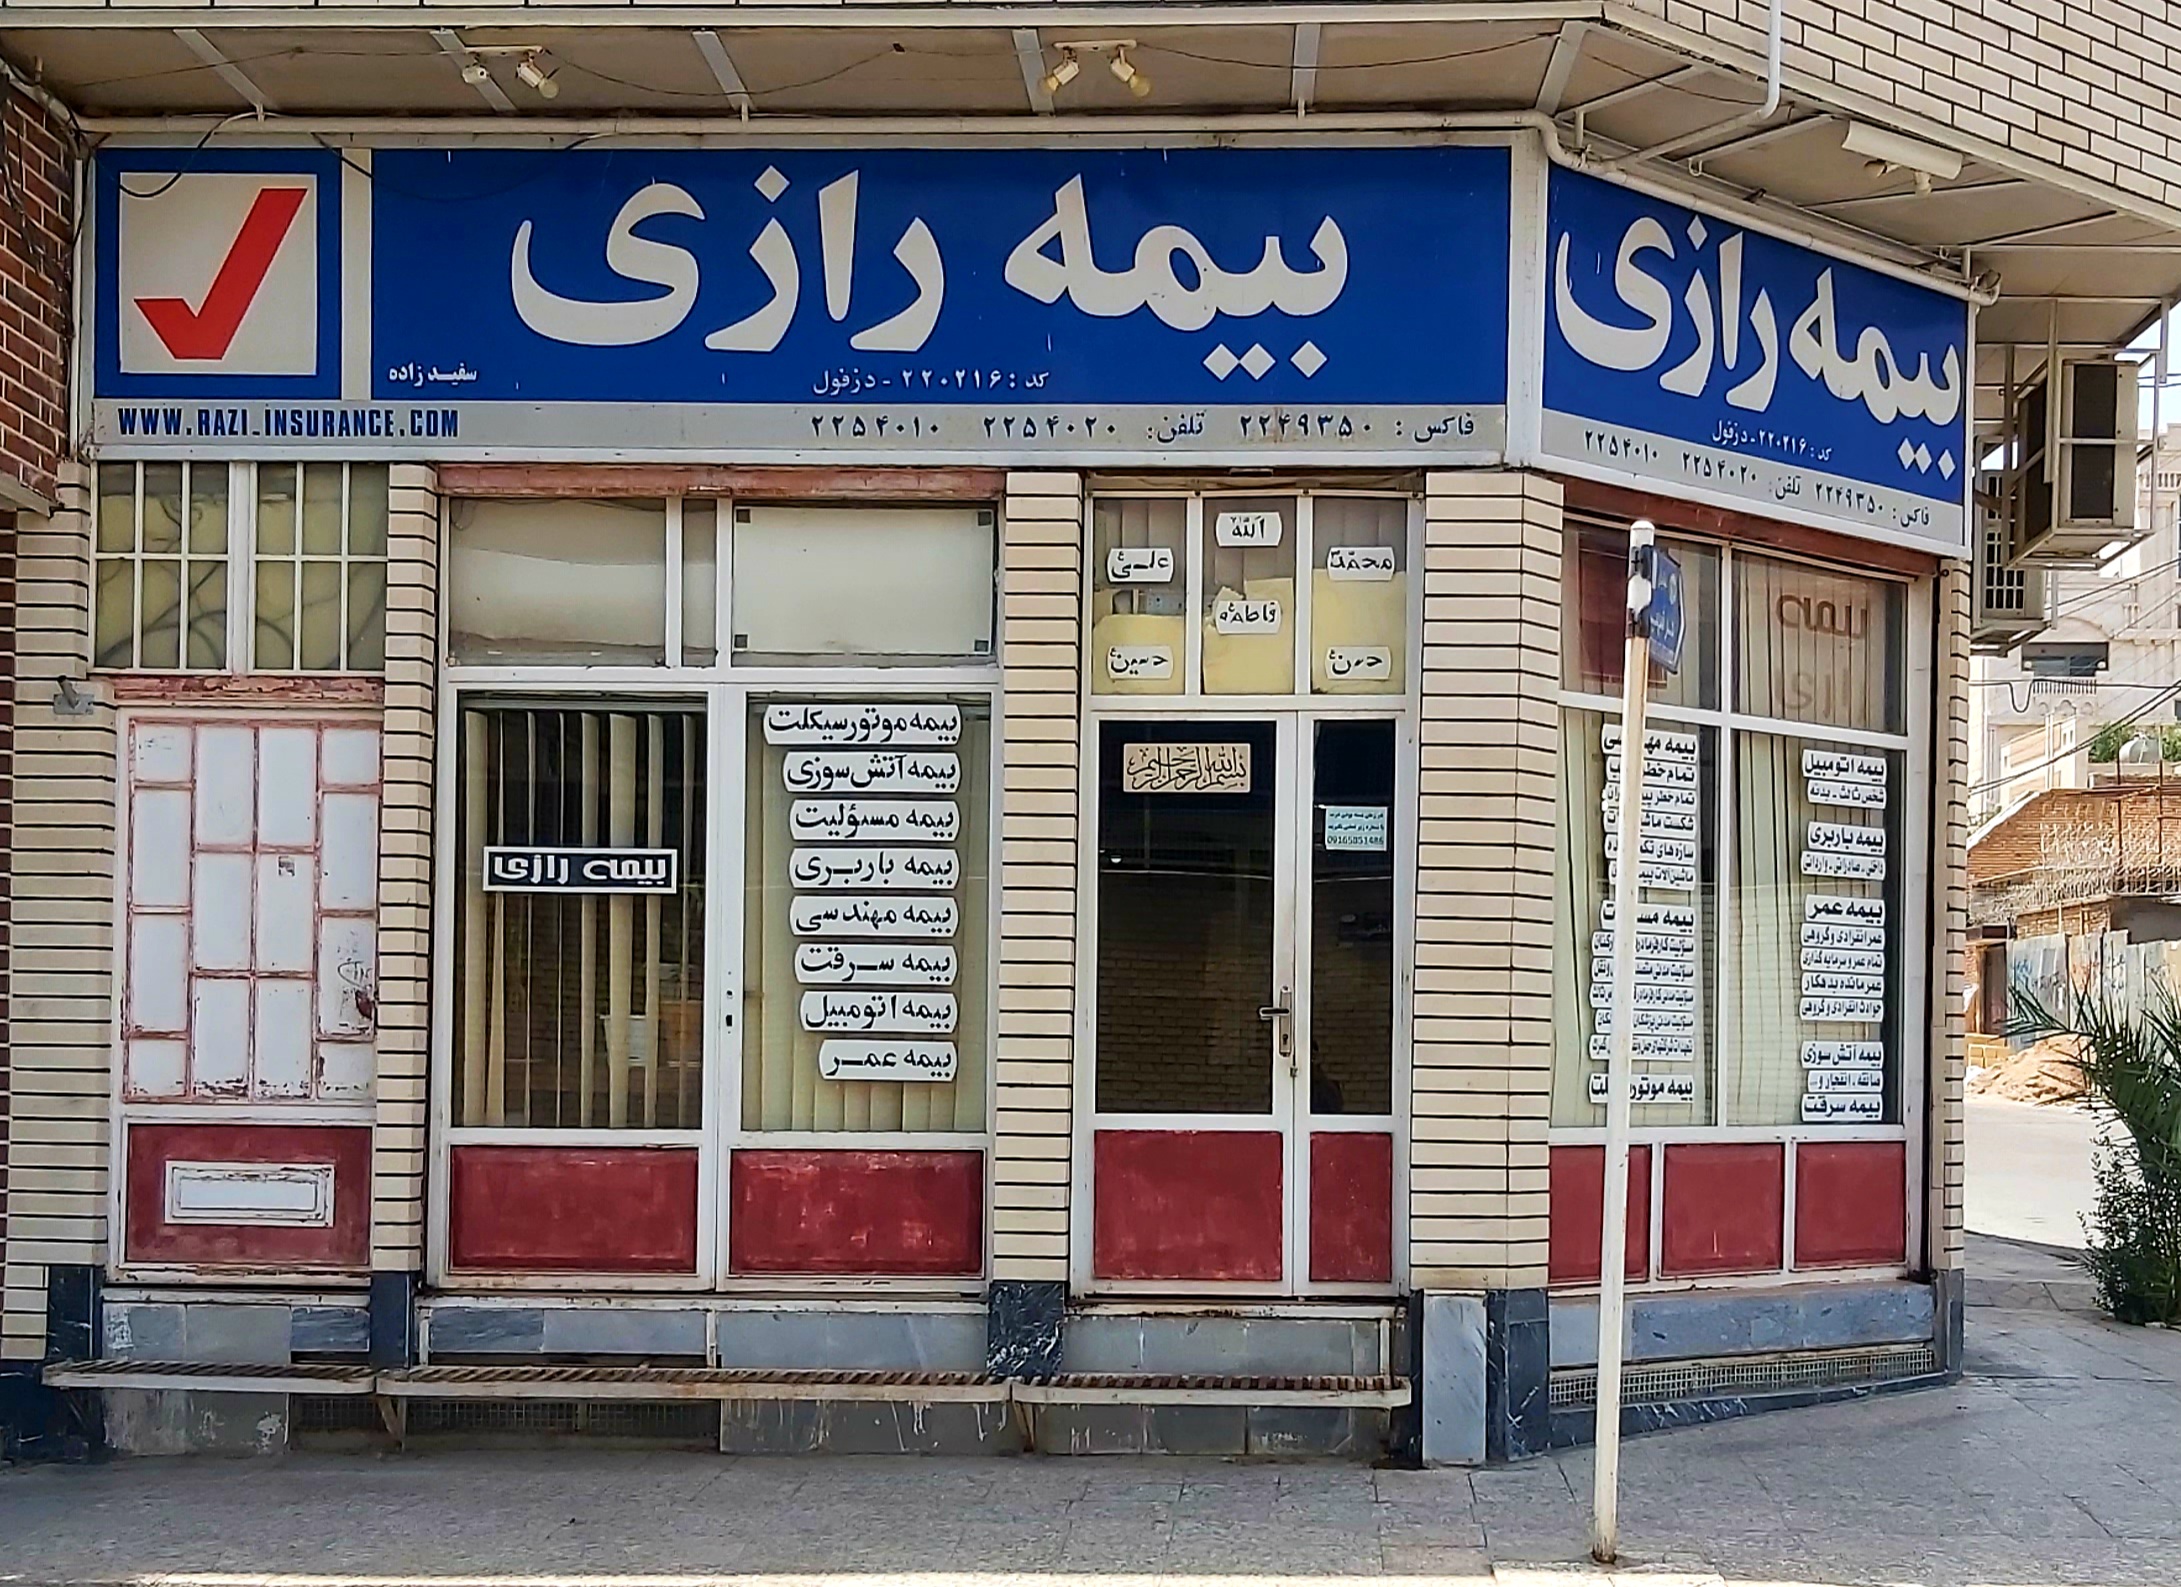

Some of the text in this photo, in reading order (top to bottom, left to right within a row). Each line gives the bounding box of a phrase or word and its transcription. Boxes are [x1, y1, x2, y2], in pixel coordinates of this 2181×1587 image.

[511, 165, 1349, 381] بیمه رازی
[1555, 214, 1962, 481] بیمه رازی
[388, 362, 478, 387] سفید زاده
[812, 367, 877, 396] دزفول
[810, 415, 940, 439] ۲۲۵۴۰۱۰
[982, 415, 1117, 439] ۲۲۵۴۰۲۰
[1239, 412, 1374, 438] ۲۲۴۹۳۵۰
[1711, 419, 1748, 446] دزفول
[1584, 430, 1659, 464] ۲۲۵۴۰۱۰
[1682, 452, 1757, 485] ۲۲۵۴۰۲۰
[768, 707, 959, 743] بیمه موتورسیکلت
[1665, 737, 1696, 761] بیمه
[907, 757, 957, 790] بیمه
[1804, 753, 1884, 783] بیمه اتومبیل
[905, 807, 954, 839] بیمه
[1810, 826, 1883, 852] بیمه باربری
[494, 854, 667, 885] بیمه رازی
[794, 850, 953, 886] بیمه باربری
[795, 901, 952, 934] بیمه مهندسی
[1662, 909, 1694, 933] بیمه
[1807, 901, 1883, 924] بیمه عمر
[800, 946, 951, 982] بیمه سرقت
[805, 994, 952, 1030] بیمه اتومبیل
[826, 1048, 952, 1078] بیمه عمر
[1804, 1095, 1881, 1118] بیمه سرقت
